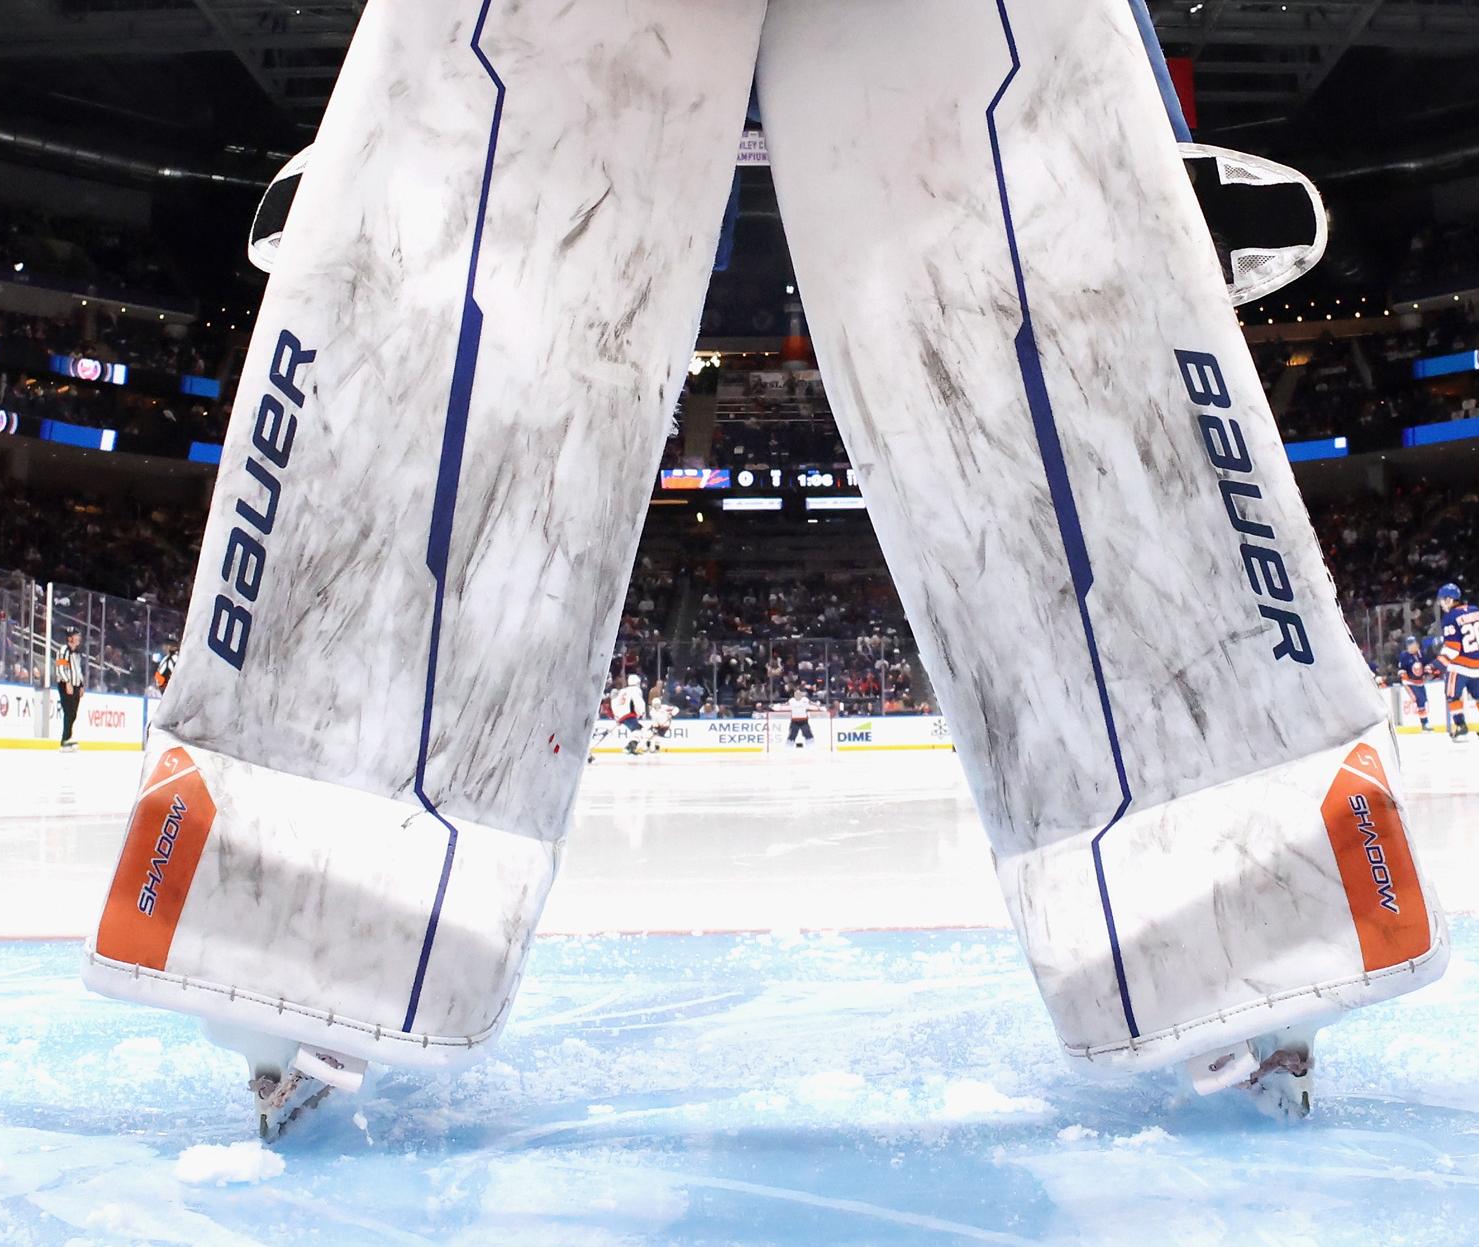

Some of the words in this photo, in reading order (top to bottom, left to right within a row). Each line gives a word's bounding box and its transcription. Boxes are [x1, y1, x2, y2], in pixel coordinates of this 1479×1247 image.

[88, 707, 126, 729] verizon
[708, 722, 781, 732] AMERICAN
[837, 732, 872, 743] DIME
[136, 793, 188, 919] SHADOW
[1347, 793, 1401, 916] SHADOW
